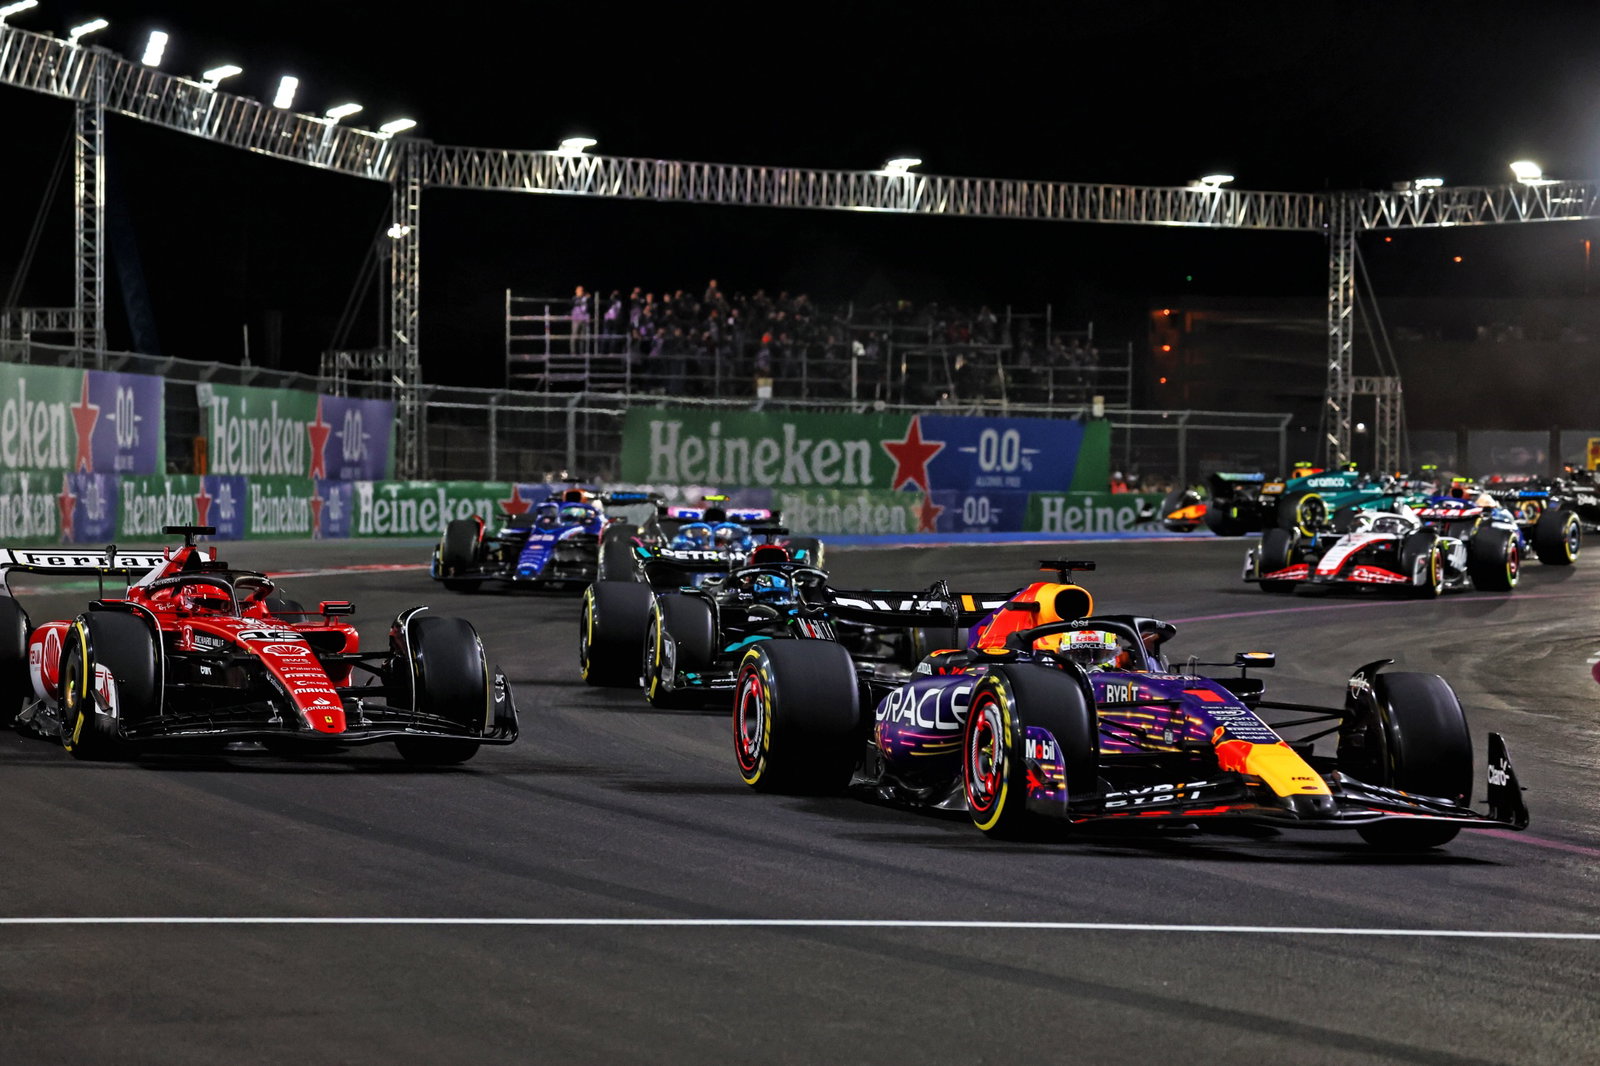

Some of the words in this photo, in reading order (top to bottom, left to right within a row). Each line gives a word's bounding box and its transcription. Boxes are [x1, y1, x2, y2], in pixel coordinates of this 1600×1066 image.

[211, 396, 305, 475] Heineken
[647, 420, 874, 486] Heineken
[1307, 477, 1346, 488] aramco
[122, 479, 194, 536] Heineken
[251, 484, 310, 534] Heineken
[782, 493, 907, 535] Heineken
[22, 552, 164, 567] Ferrar
[194, 635, 212, 646] RICHARD
[876, 686, 973, 730] ORACLE
[1025, 739, 1056, 761] Mobil
